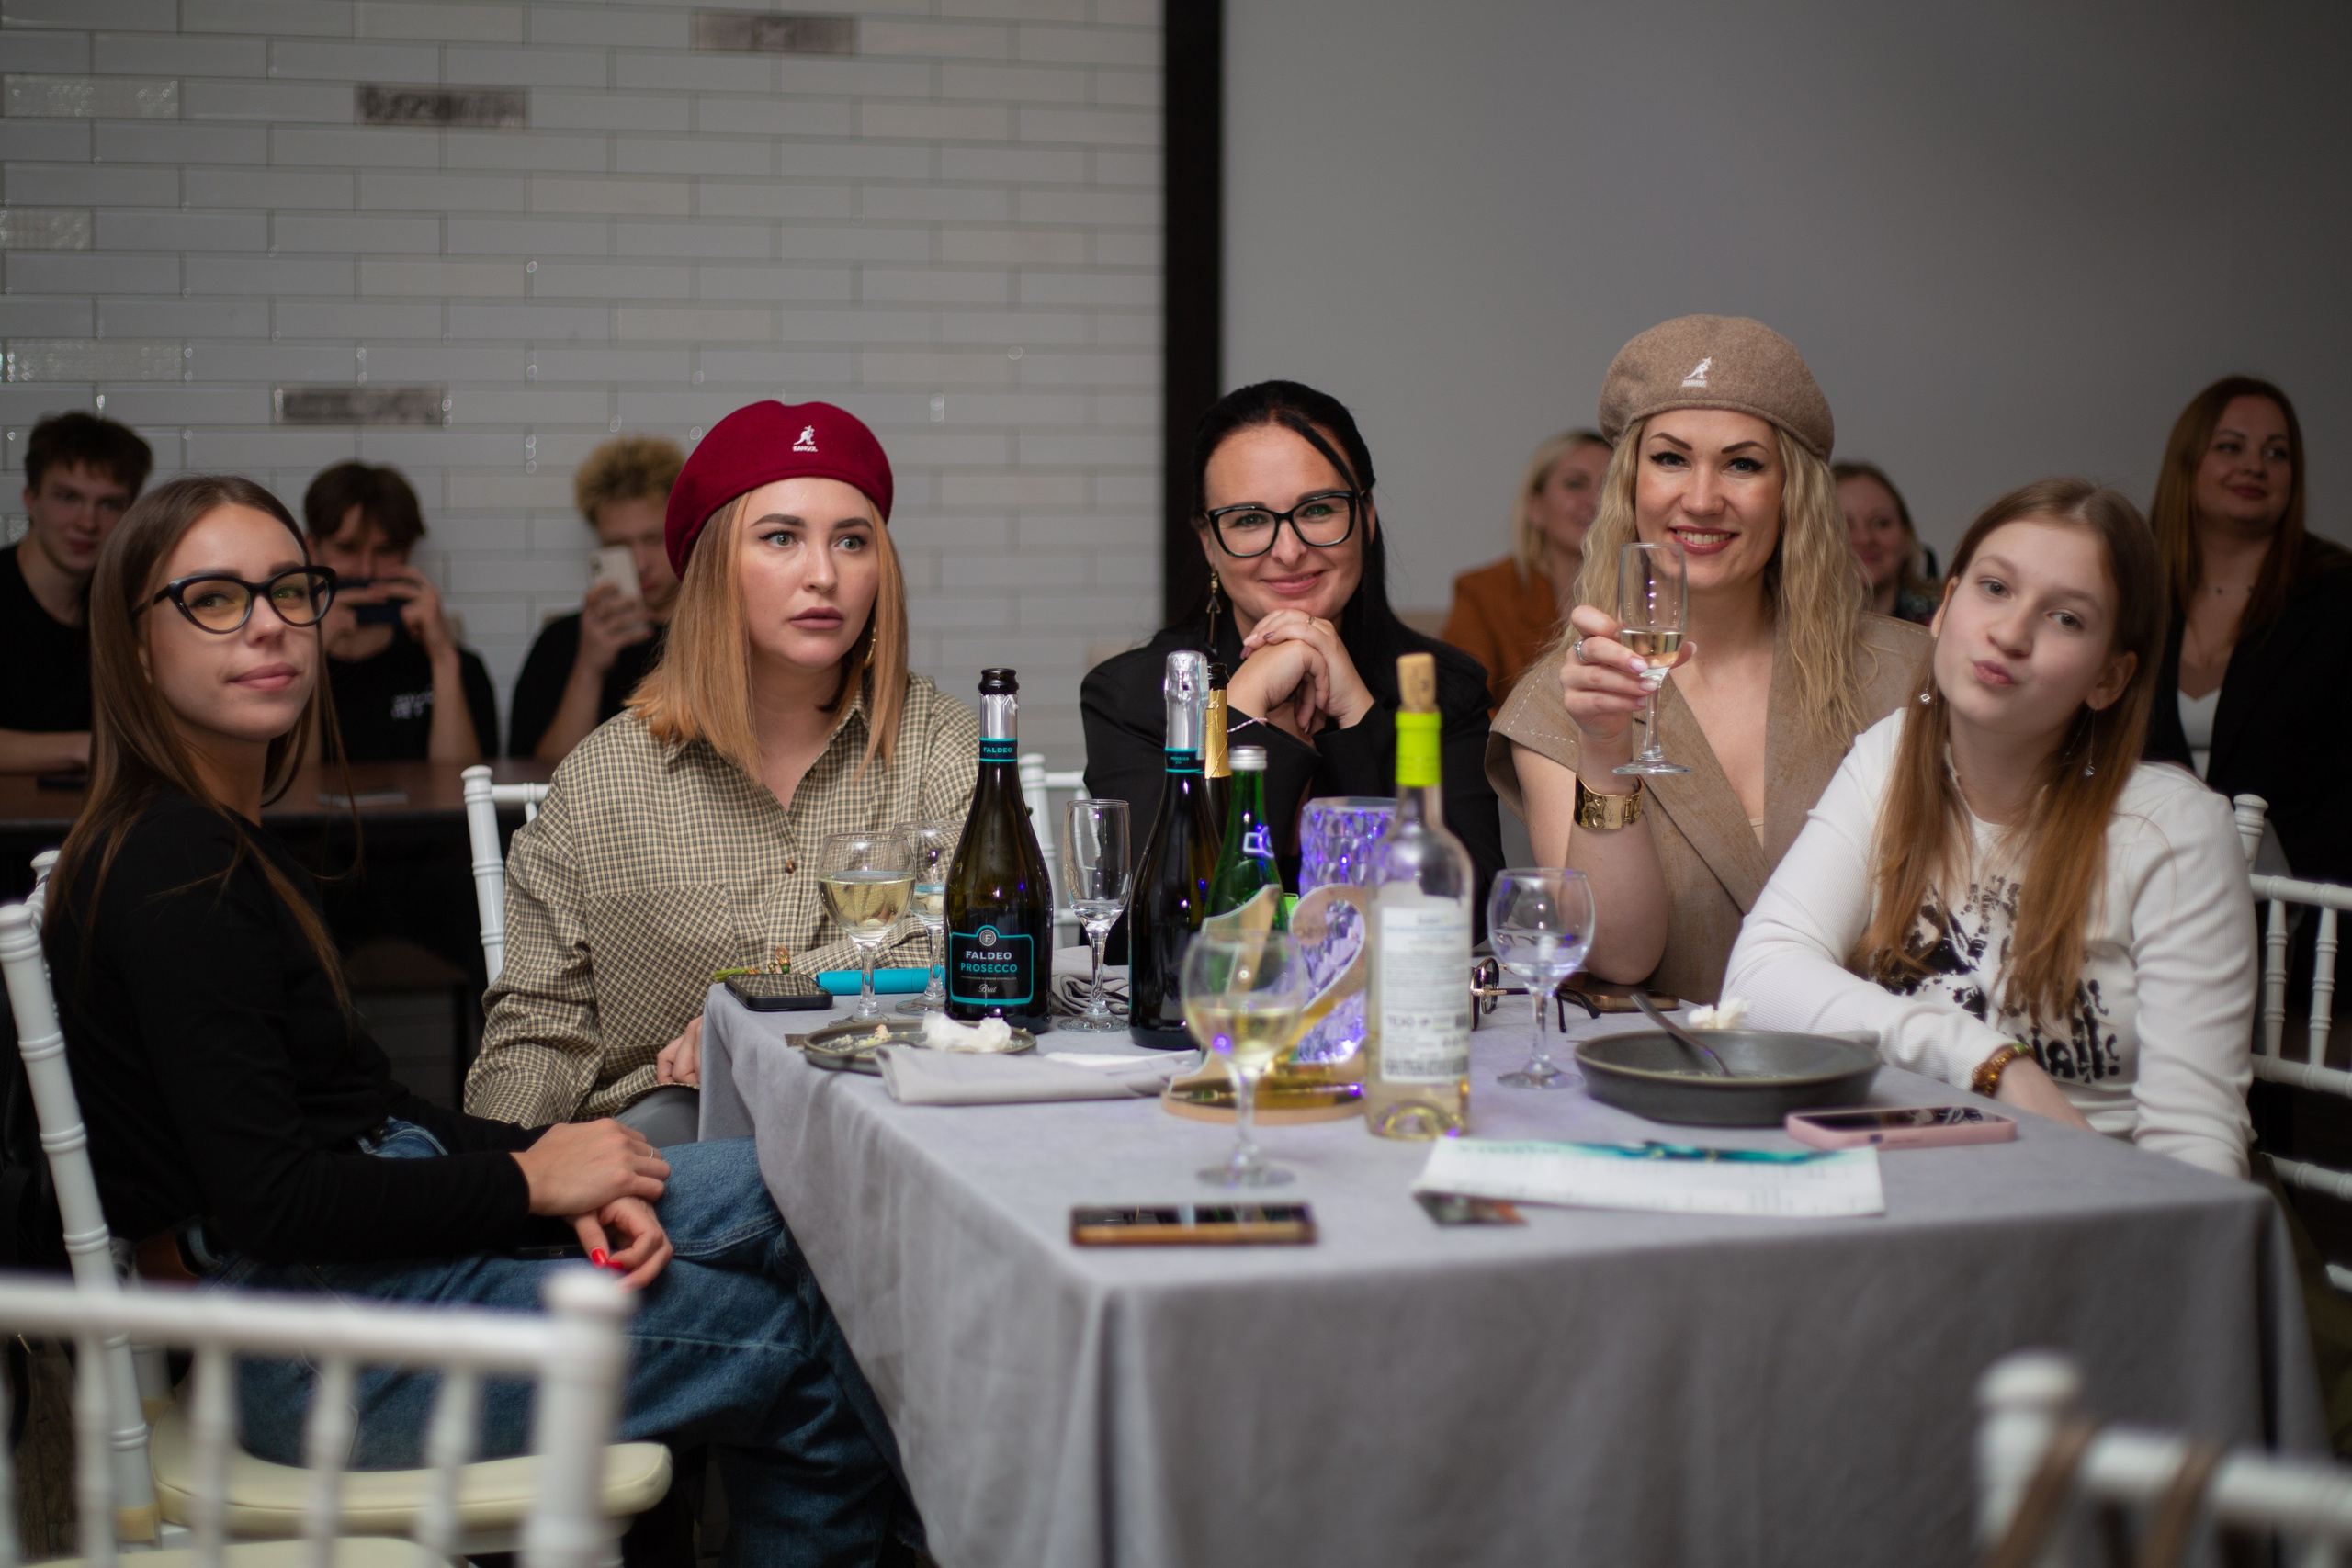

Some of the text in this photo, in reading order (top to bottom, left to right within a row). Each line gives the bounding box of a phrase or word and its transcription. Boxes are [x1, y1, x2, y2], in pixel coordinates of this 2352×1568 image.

[965, 950, 1012, 960] FALDEO
[960, 962, 1018, 973] PROSECCO
[978, 983, 998, 993] Brut
